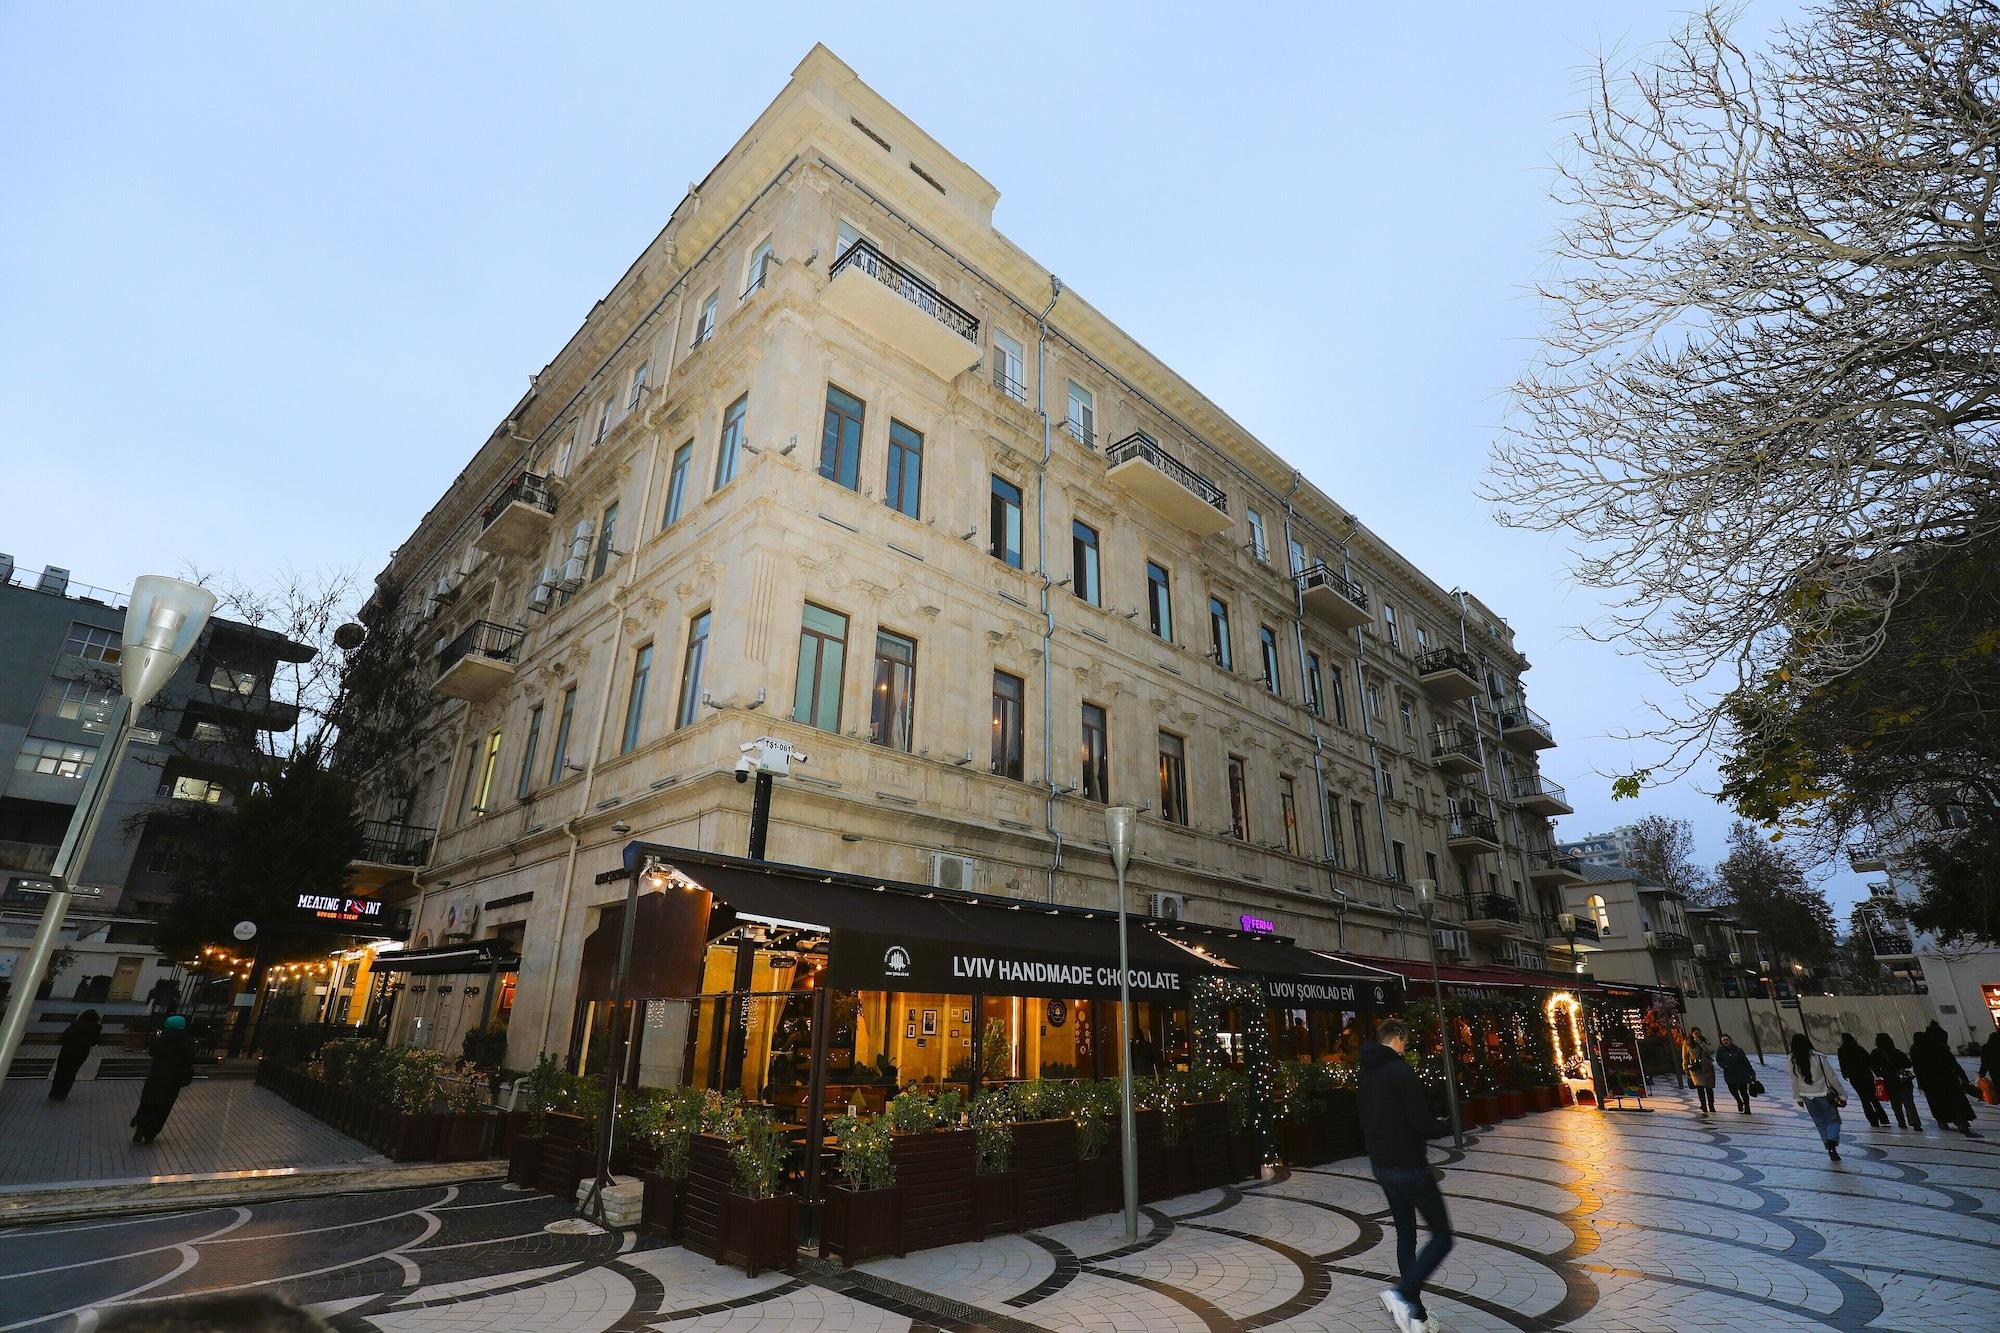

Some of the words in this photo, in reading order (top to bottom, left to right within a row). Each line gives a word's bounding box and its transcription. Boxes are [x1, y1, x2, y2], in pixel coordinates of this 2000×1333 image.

[297, 894, 340, 911] MEATING
[1251, 919, 1274, 932] FERMA
[953, 956, 994, 978] LVIV
[998, 960, 1094, 985] HANDMADE
[1269, 982, 1295, 998] LVOV
[1297, 984, 1340, 1001] ŞOKOLAD
[1340, 984, 1355, 1001] EVİ
